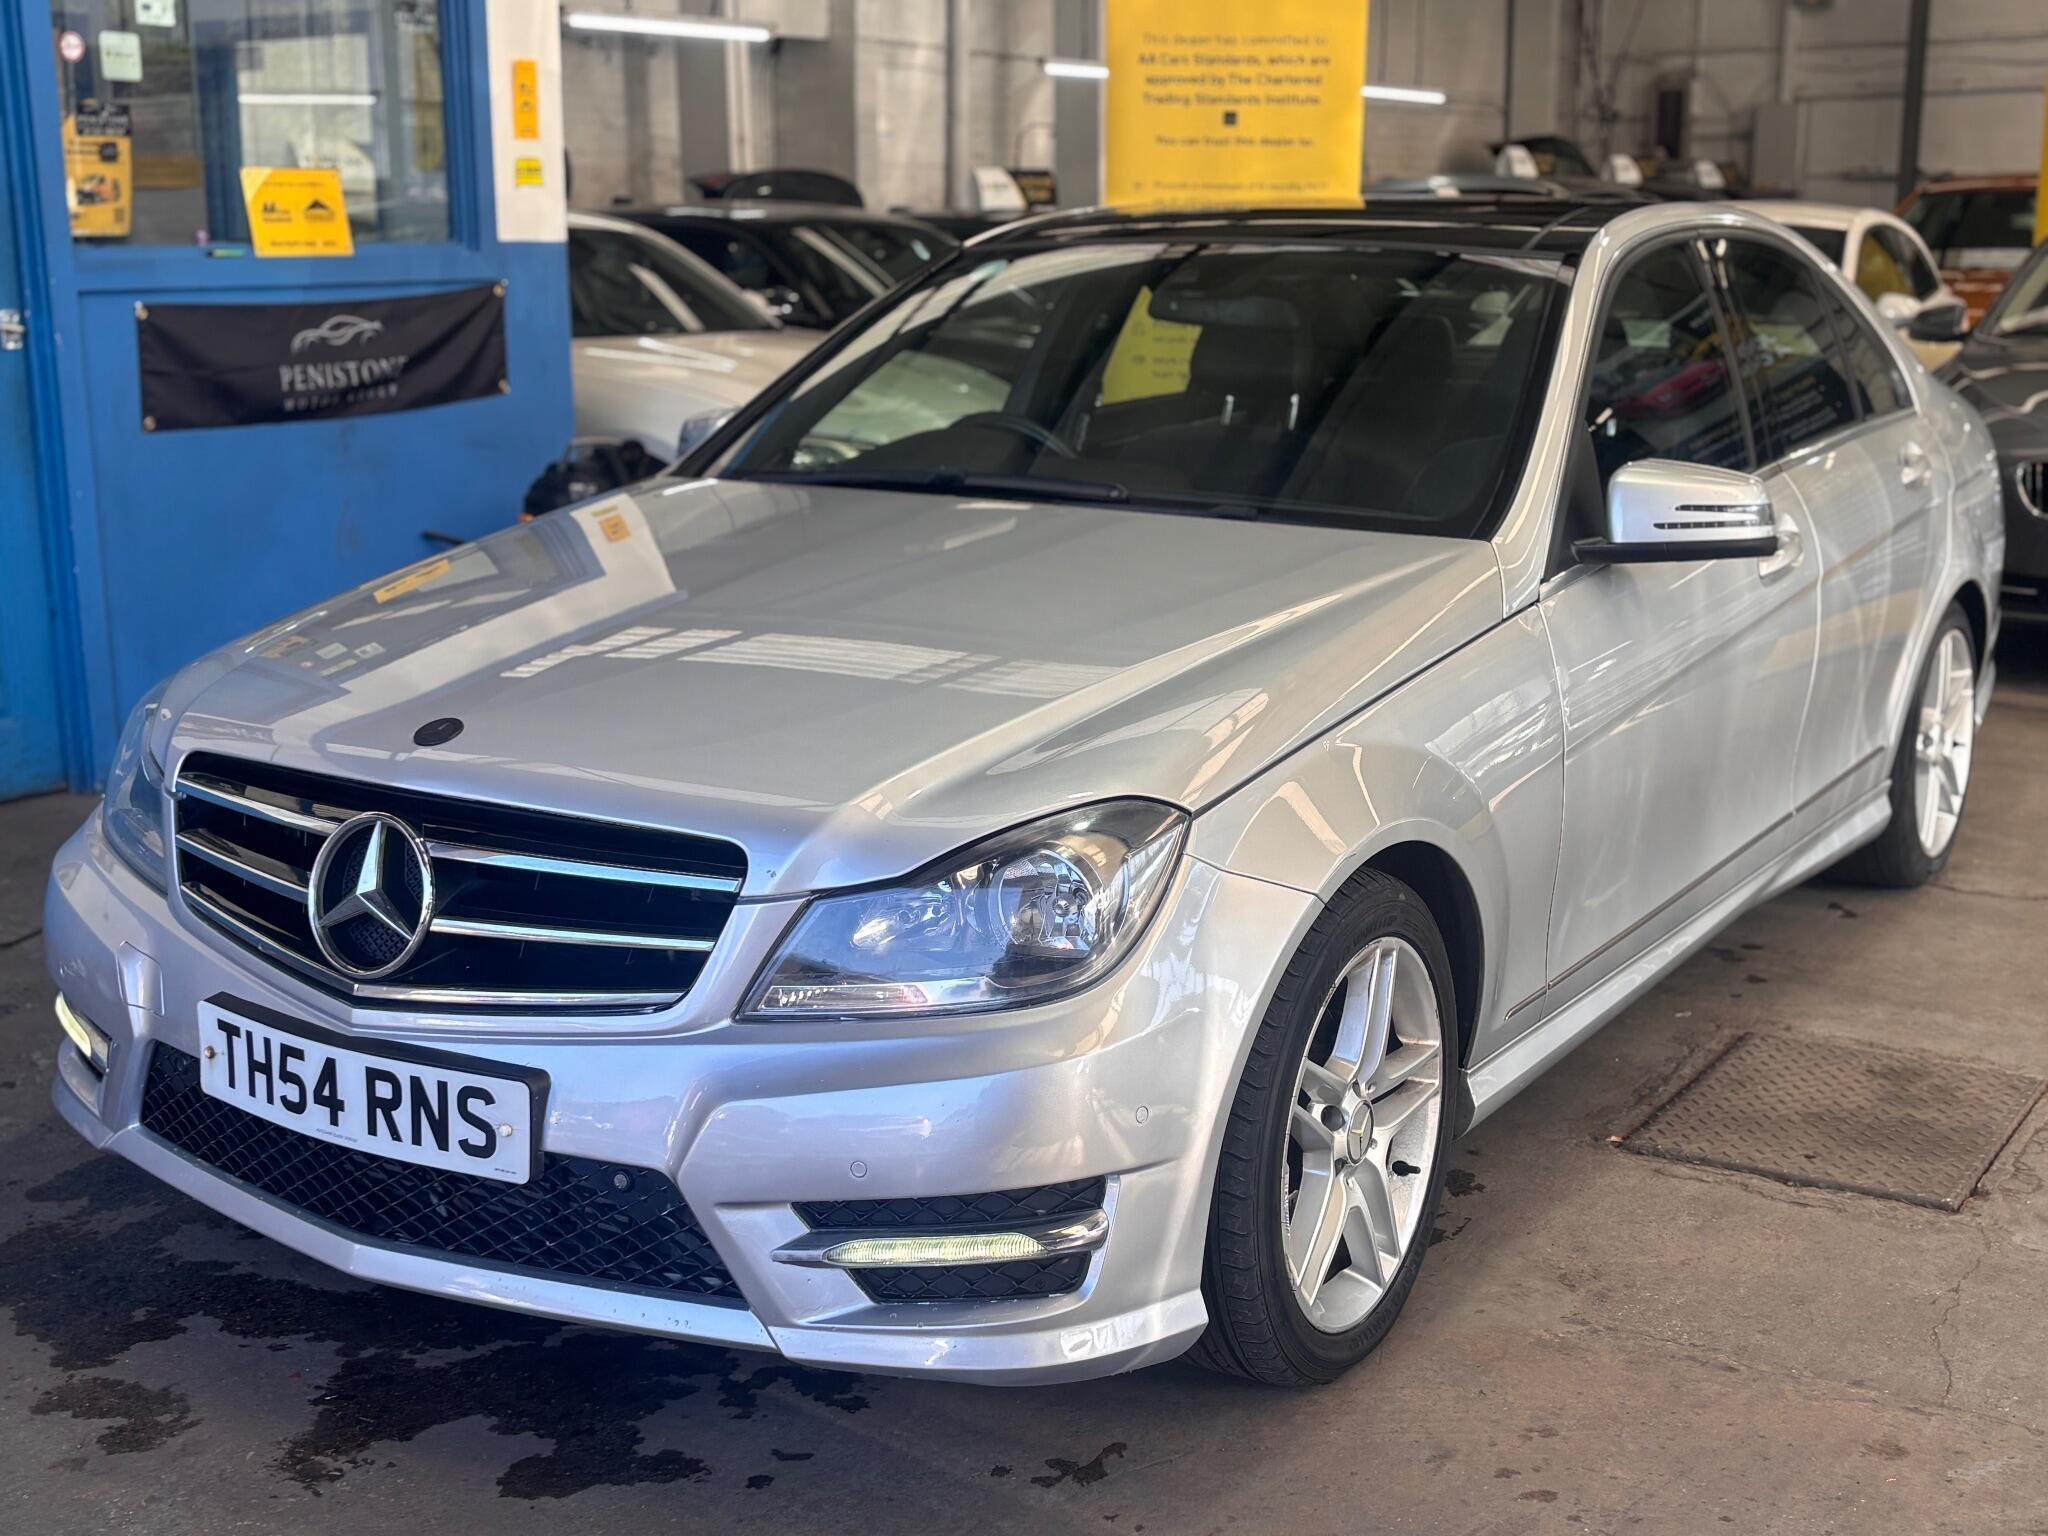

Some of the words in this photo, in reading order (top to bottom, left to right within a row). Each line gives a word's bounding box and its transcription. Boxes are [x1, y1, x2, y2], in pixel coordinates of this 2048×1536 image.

[1266, 52, 1305, 65] which
[1310, 55, 1331, 65] are
[1145, 74, 1206, 86] approved
[1209, 74, 1225, 87] by
[1229, 72, 1252, 85] The
[1256, 73, 1323, 86] Chartered
[1142, 91, 1191, 108] Trading
[1195, 91, 1261, 106] Standards
[217, 1018, 345, 1127] TH54
[364, 1066, 498, 1159] RNS
